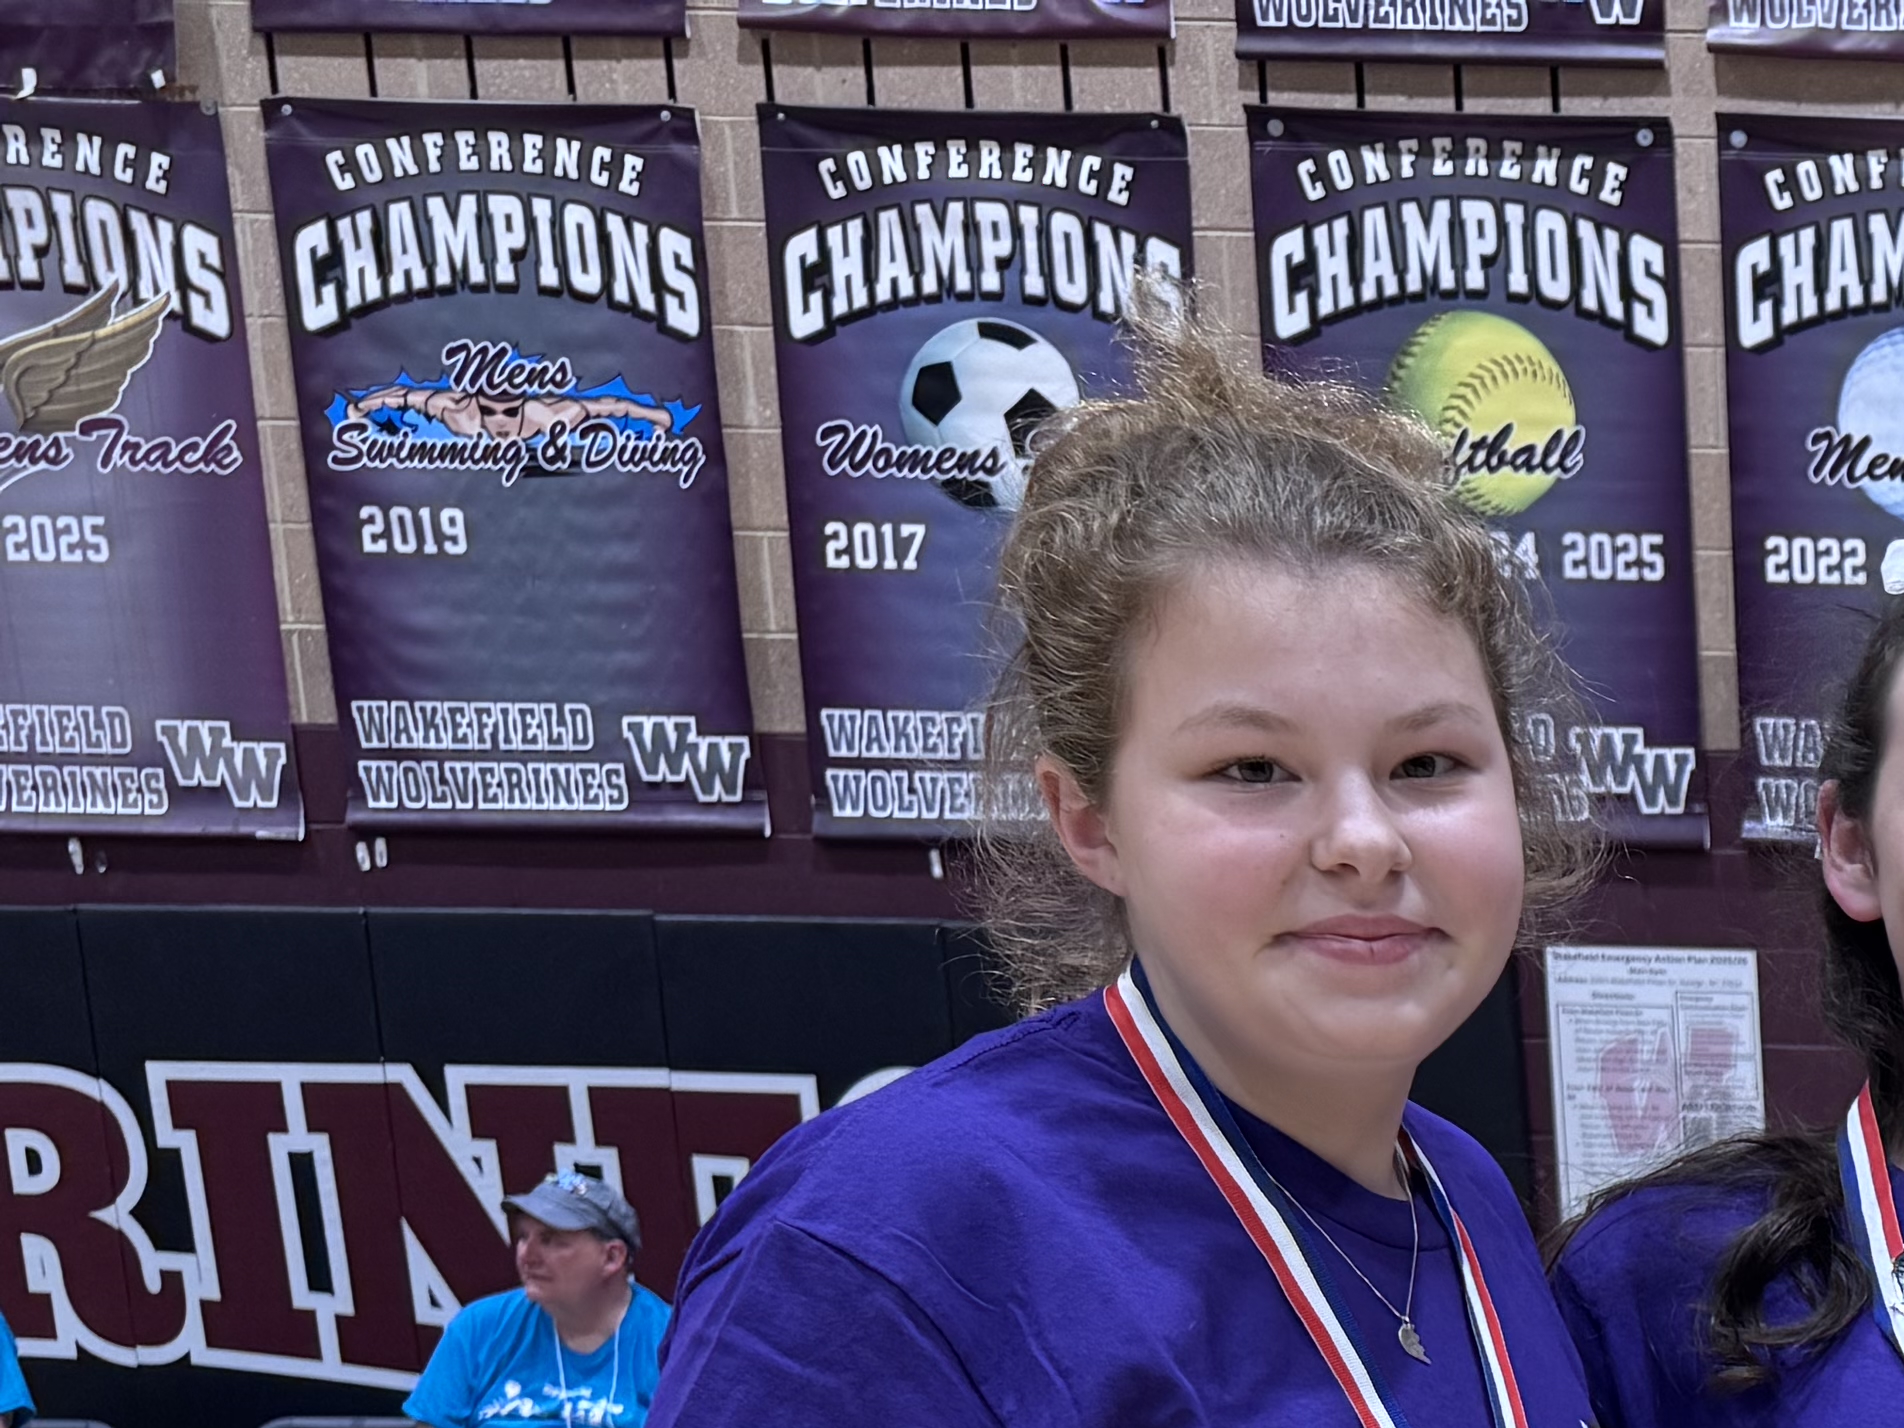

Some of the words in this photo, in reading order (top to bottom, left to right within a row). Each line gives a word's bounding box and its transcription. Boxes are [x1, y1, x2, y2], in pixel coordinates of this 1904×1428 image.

[1, 123, 172, 195] RENCE
[325, 129, 646, 198] CONFERENCE
[817, 138, 1135, 206] CONFERENCE
[1296, 136, 1630, 207] CONFERENCE
[0, 186, 234, 342] PIONS
[292, 193, 703, 341] CHAMPIONS
[1267, 198, 1670, 350] CHAMPIONS
[441, 338, 577, 396] Mens
[76, 414, 243, 475] Track
[327, 420, 529, 487] Swimming
[540, 420, 571, 470] &
[576, 421, 706, 488] Diving
[815, 419, 1007, 481] Womens
[2, 515, 110, 563] 2025
[359, 505, 468, 556] 2019
[824, 521, 927, 571] 2017
[1562, 531, 1666, 582] 2025
[1764, 535, 1867, 585] 2022
[0, 704, 133, 756] FIELD
[351, 699, 594, 751] WAKEFIELD
[820, 708, 986, 761] WAKEFI
[0, 763, 169, 816] ERINES
[357, 759, 629, 811] WOLVERINES
